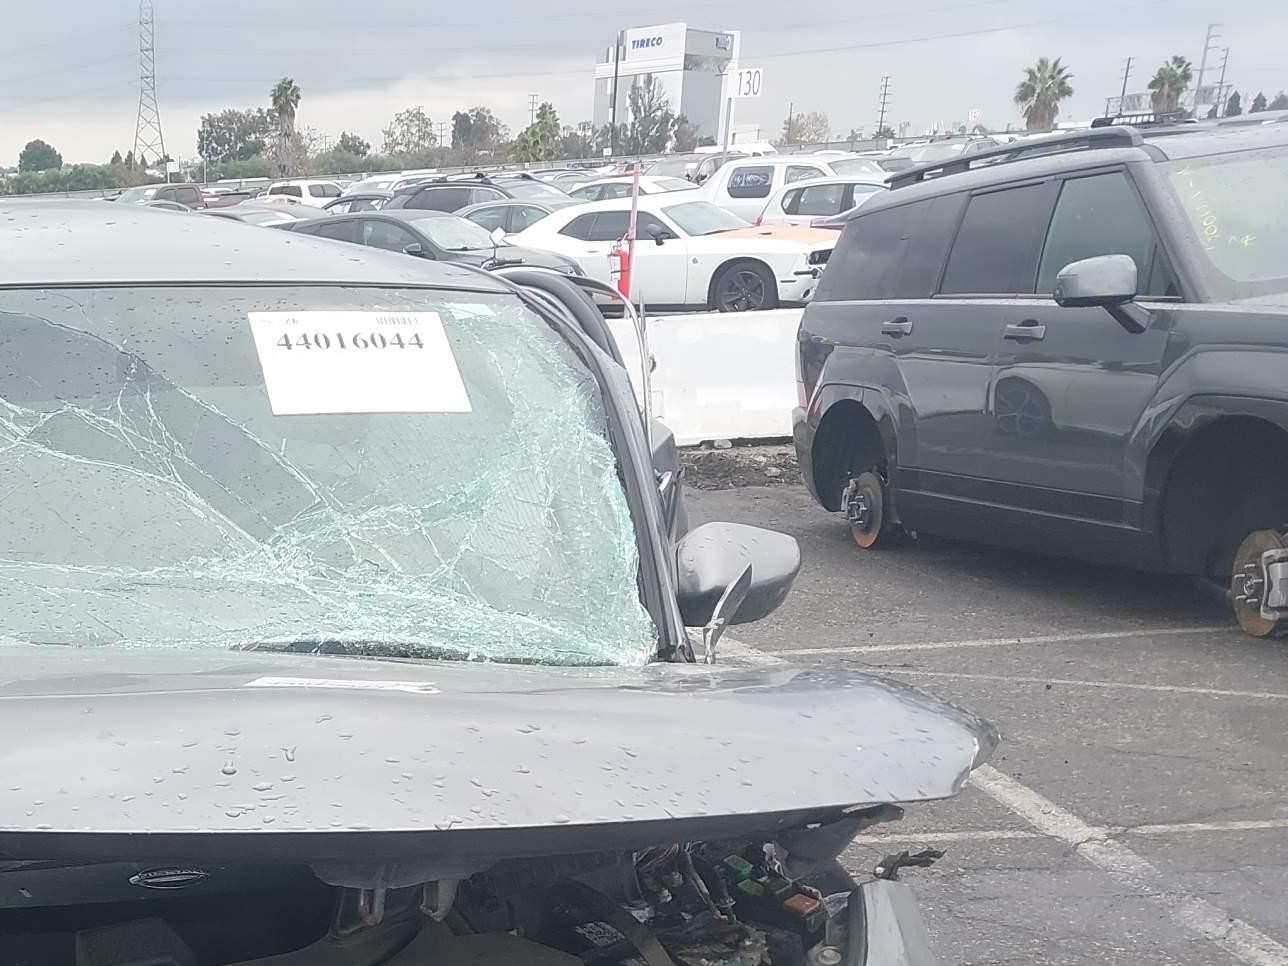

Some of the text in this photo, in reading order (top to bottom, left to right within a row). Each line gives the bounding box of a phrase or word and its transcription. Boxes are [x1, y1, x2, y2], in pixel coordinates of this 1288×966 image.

[631, 36, 663, 50] TIRECO
[737, 70, 761, 96] 130
[277, 331, 425, 350] 44016044
